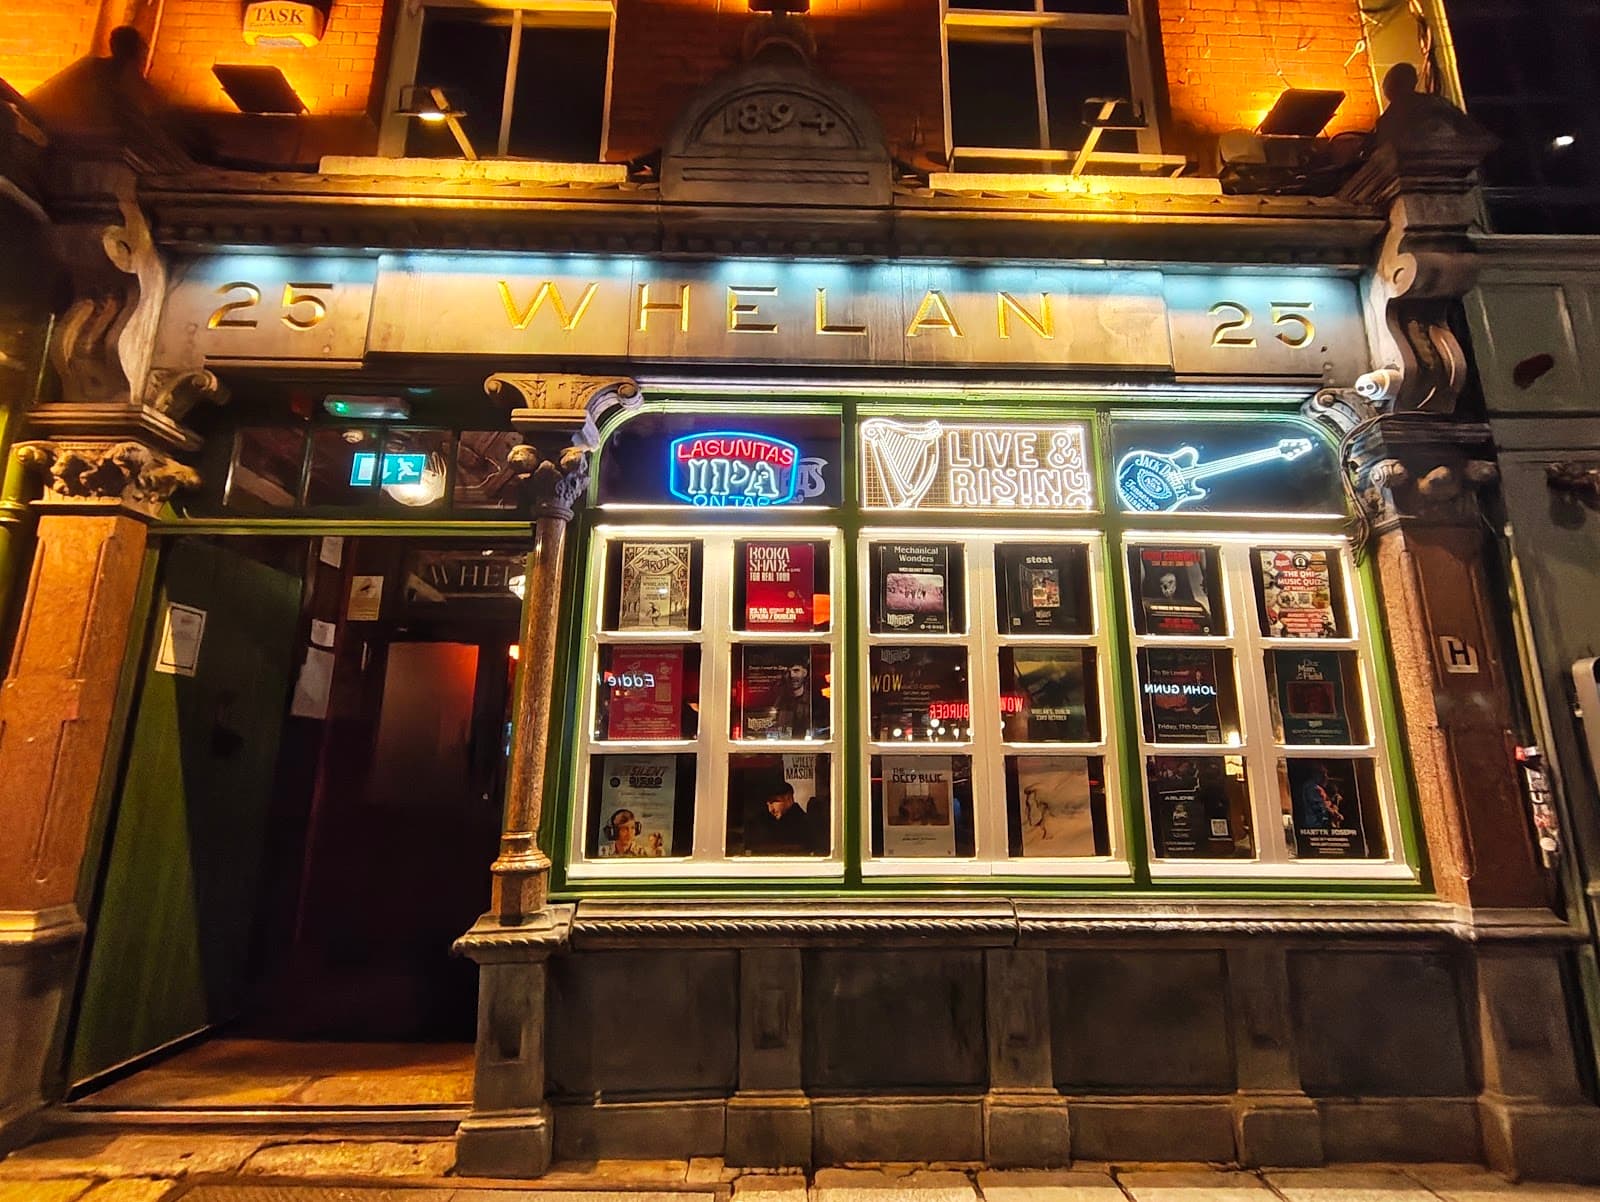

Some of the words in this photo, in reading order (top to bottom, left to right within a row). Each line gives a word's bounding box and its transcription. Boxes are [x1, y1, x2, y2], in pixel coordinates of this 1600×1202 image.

[254, 7, 304, 23] TASK
[722, 103, 836, 136] 1894
[207, 281, 333, 331] 25
[498, 281, 1054, 340] WHELAN
[1207, 301, 1315, 349] 25
[677, 439, 794, 465] LAGUNITAS
[948, 431, 1040, 469] LIVE
[1047, 431, 1081, 469] &
[1134, 454, 1163, 473] JACK
[687, 458, 780, 497] IPA
[949, 468, 1091, 507] RISING
[692, 494, 726, 507] ON
[893, 545, 939, 555] Mechanical
[898, 554, 934, 563] Wonders
[1025, 555, 1054, 564] stoat
[749, 559, 790, 572] SHADE
[750, 571, 761, 582] FOR
[761, 571, 774, 582] REAL
[1284, 570, 1298, 578] THE
[1277, 578, 1303, 586] MUSIC
[1302, 578, 1322, 587] QUIZ
[1447, 639, 1471, 666] H
[871, 673, 903, 693] WOW
[1157, 723, 1178, 731] Friday,
[791, 755, 816, 768] WILLY
[630, 765, 667, 777] SILENT
[785, 767, 814, 781] MASON
[892, 767, 905, 775] THE
[892, 774, 917, 784] DEEP
